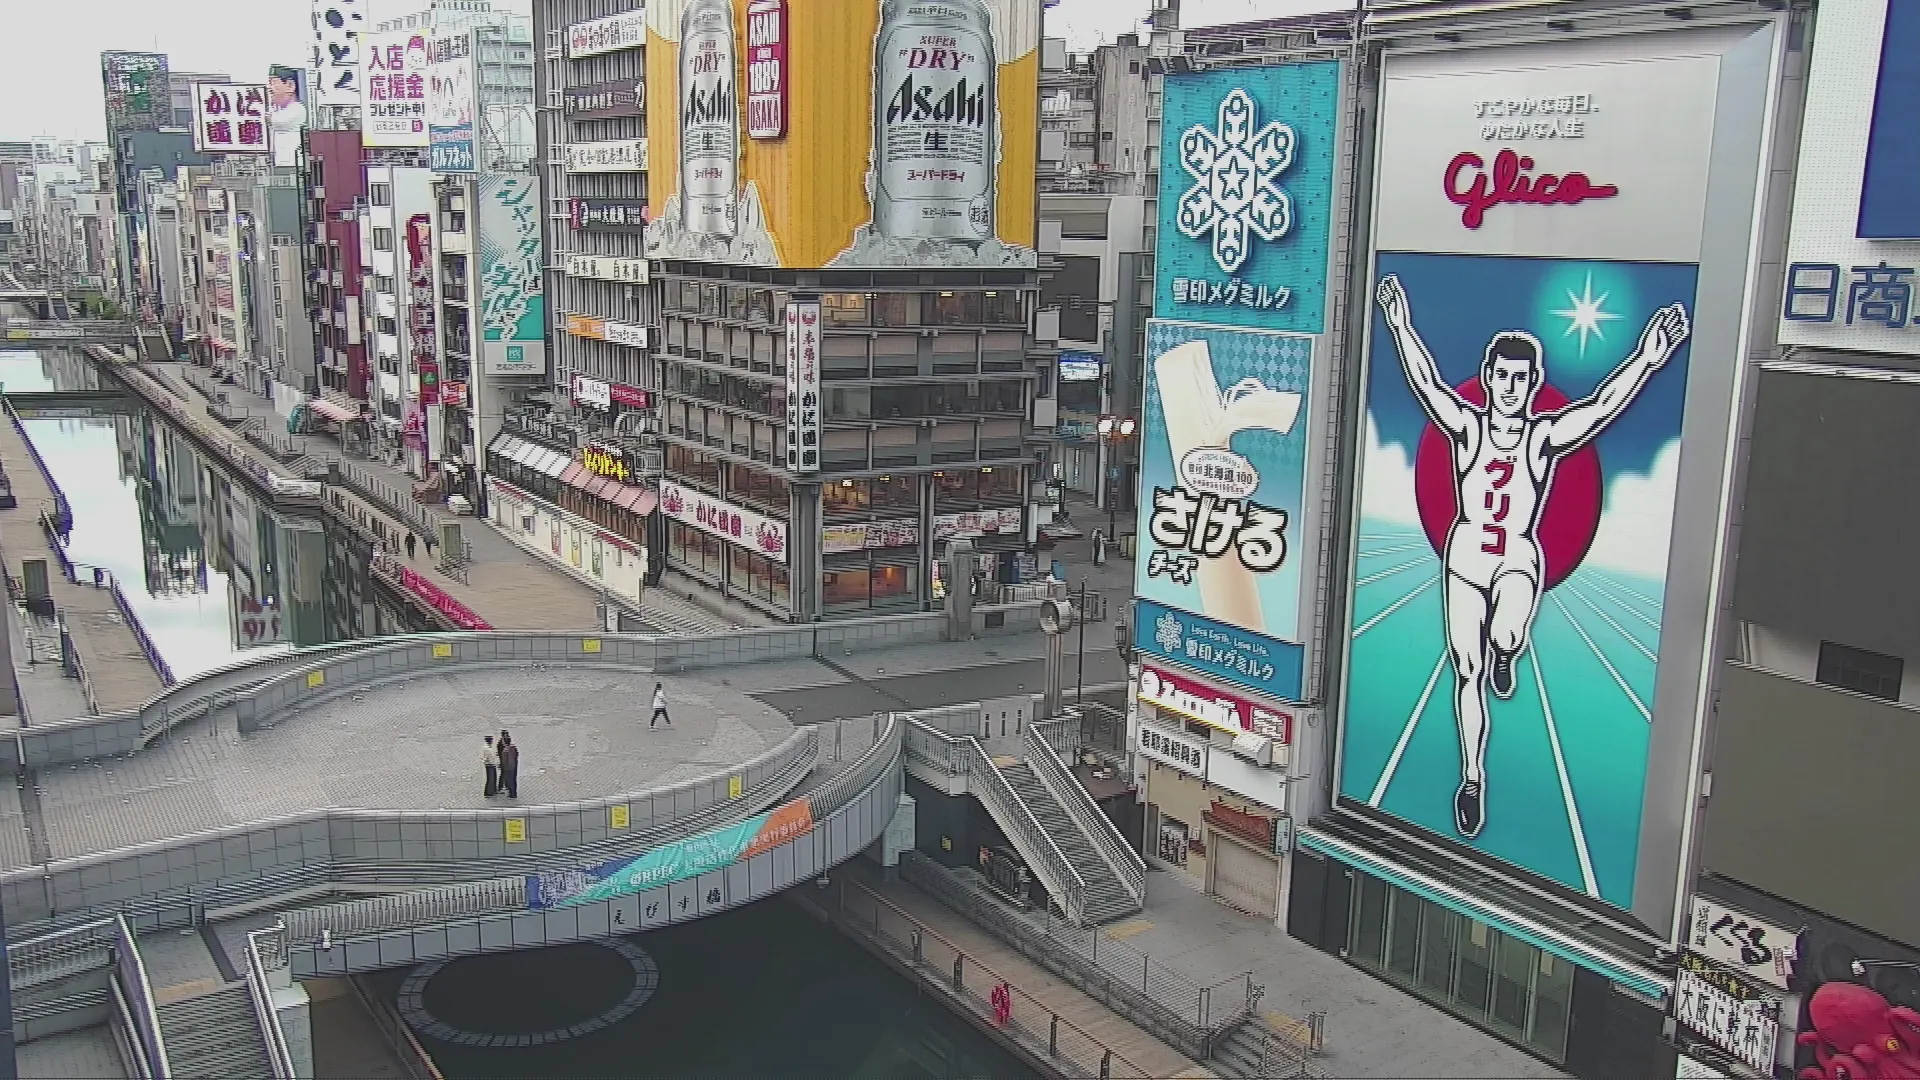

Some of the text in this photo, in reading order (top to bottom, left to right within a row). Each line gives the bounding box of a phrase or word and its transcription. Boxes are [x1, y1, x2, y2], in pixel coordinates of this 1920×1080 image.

[749, 14, 779, 47] ASAHI
[368, 44, 404, 70] 入店
[370, 73, 425, 100] 応援金
[749, 60, 780, 94] 1889
[204, 88, 264, 117] かに
[685, 76, 731, 130] Asahi
[749, 99, 780, 130] OSAKA
[887, 73, 984, 128] Asahi
[701, 131, 715, 152] 生
[924, 131, 949, 152] 生
[1480, 117, 1586, 142] ゆたかな人生
[1171, 277, 1292, 313] 雪印メグミルク
[1784, 261, 1920, 329] 日商
[1480, 456, 1518, 556] グリコ
[1150, 487, 1289, 572] さける
[1147, 551, 1198, 585] チーズ
[1185, 638, 1274, 682] 雪印メグミルク
